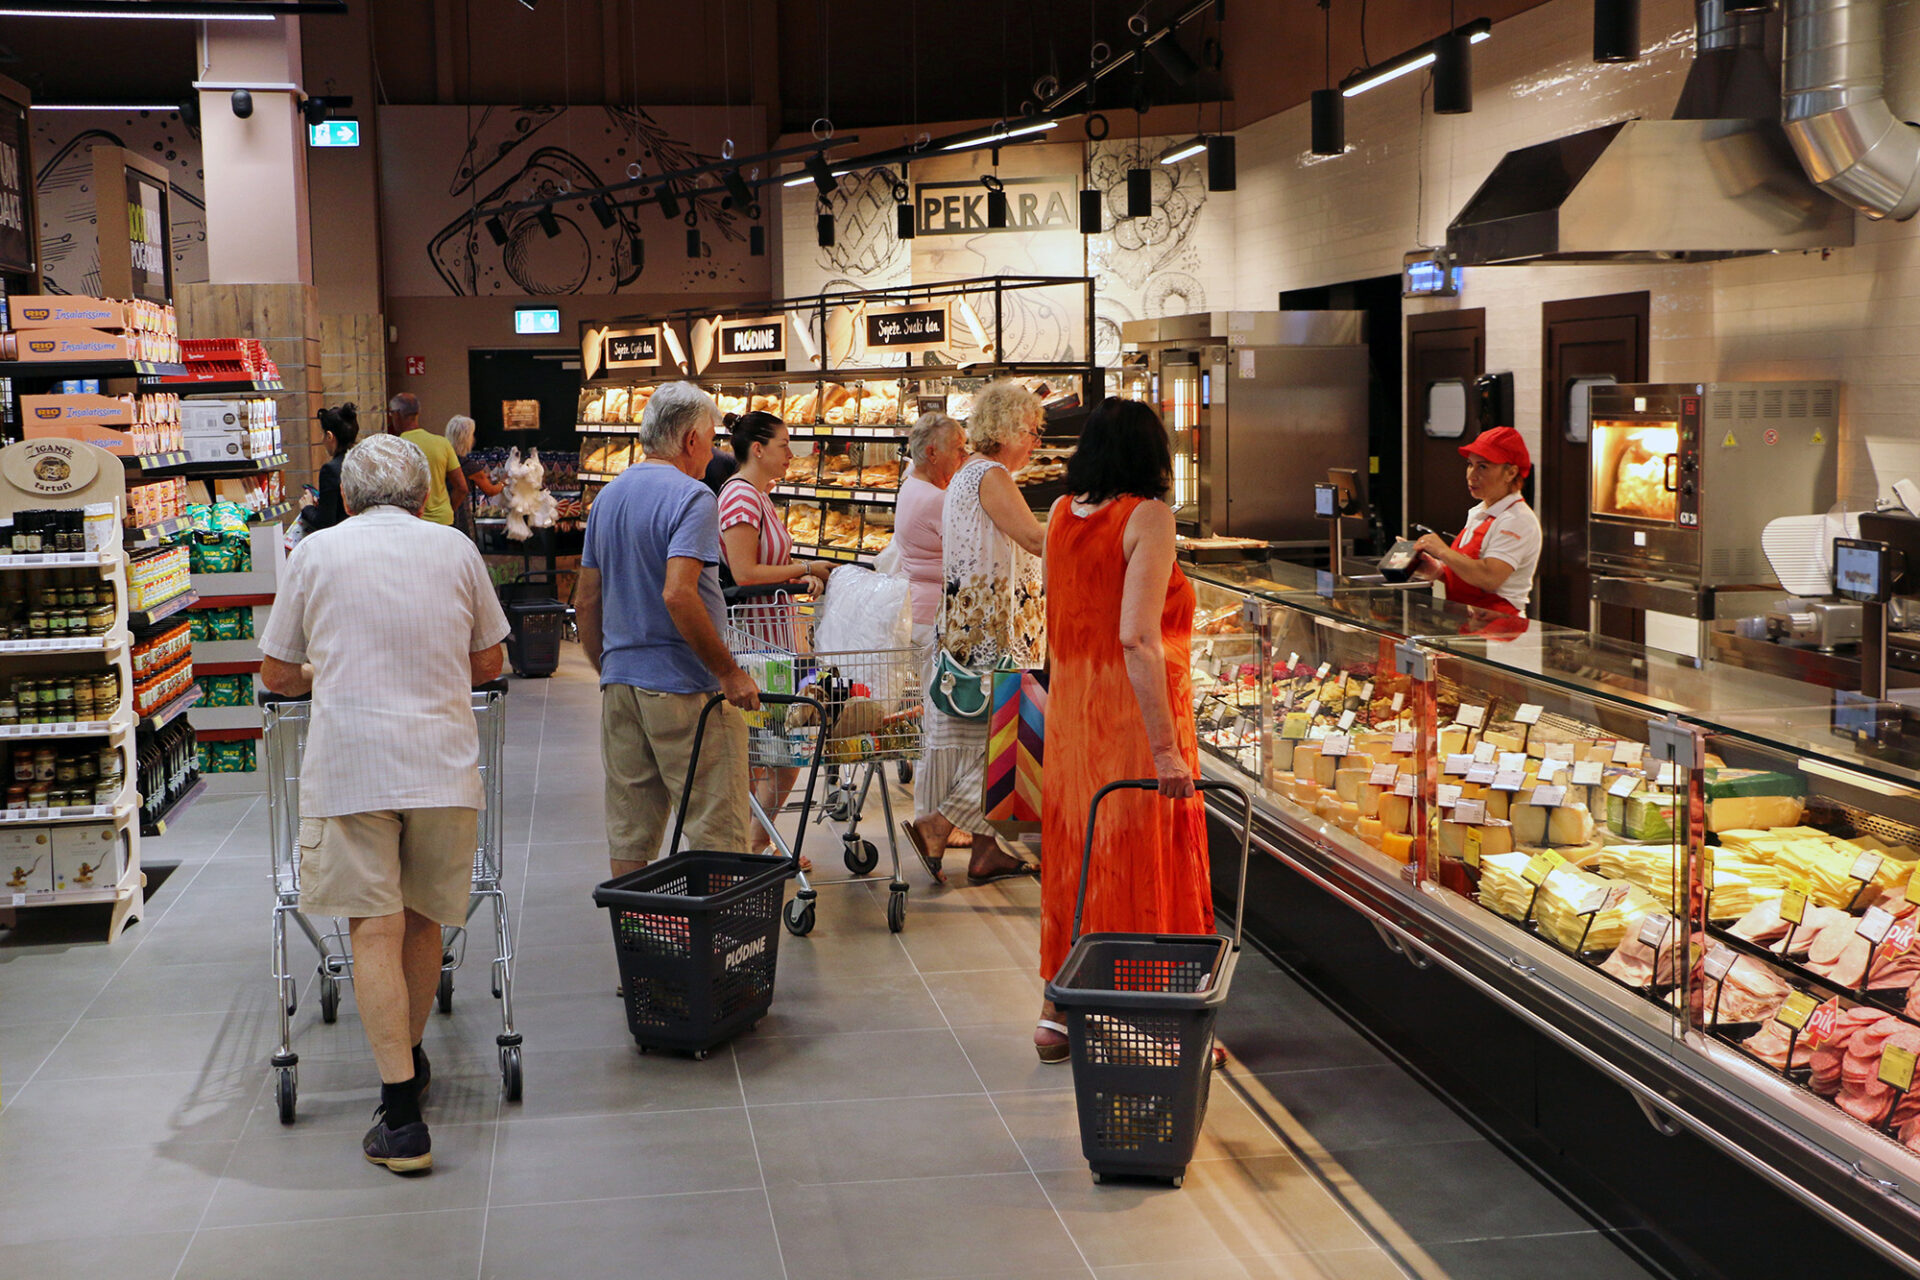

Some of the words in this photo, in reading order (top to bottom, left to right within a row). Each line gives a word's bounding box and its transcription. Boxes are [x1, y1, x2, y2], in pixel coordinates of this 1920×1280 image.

[54, 309, 111, 320] Insalatissime
[903, 317, 923, 335] Svaki
[60, 341, 117, 352] Insalatissime
[734, 328, 775, 352] PLODINE
[65, 407, 122, 418] Insalatissime
[34, 481, 73, 492] tartufi
[725, 935, 766, 971] PLODINE
[1806, 1009, 1836, 1034] pik
